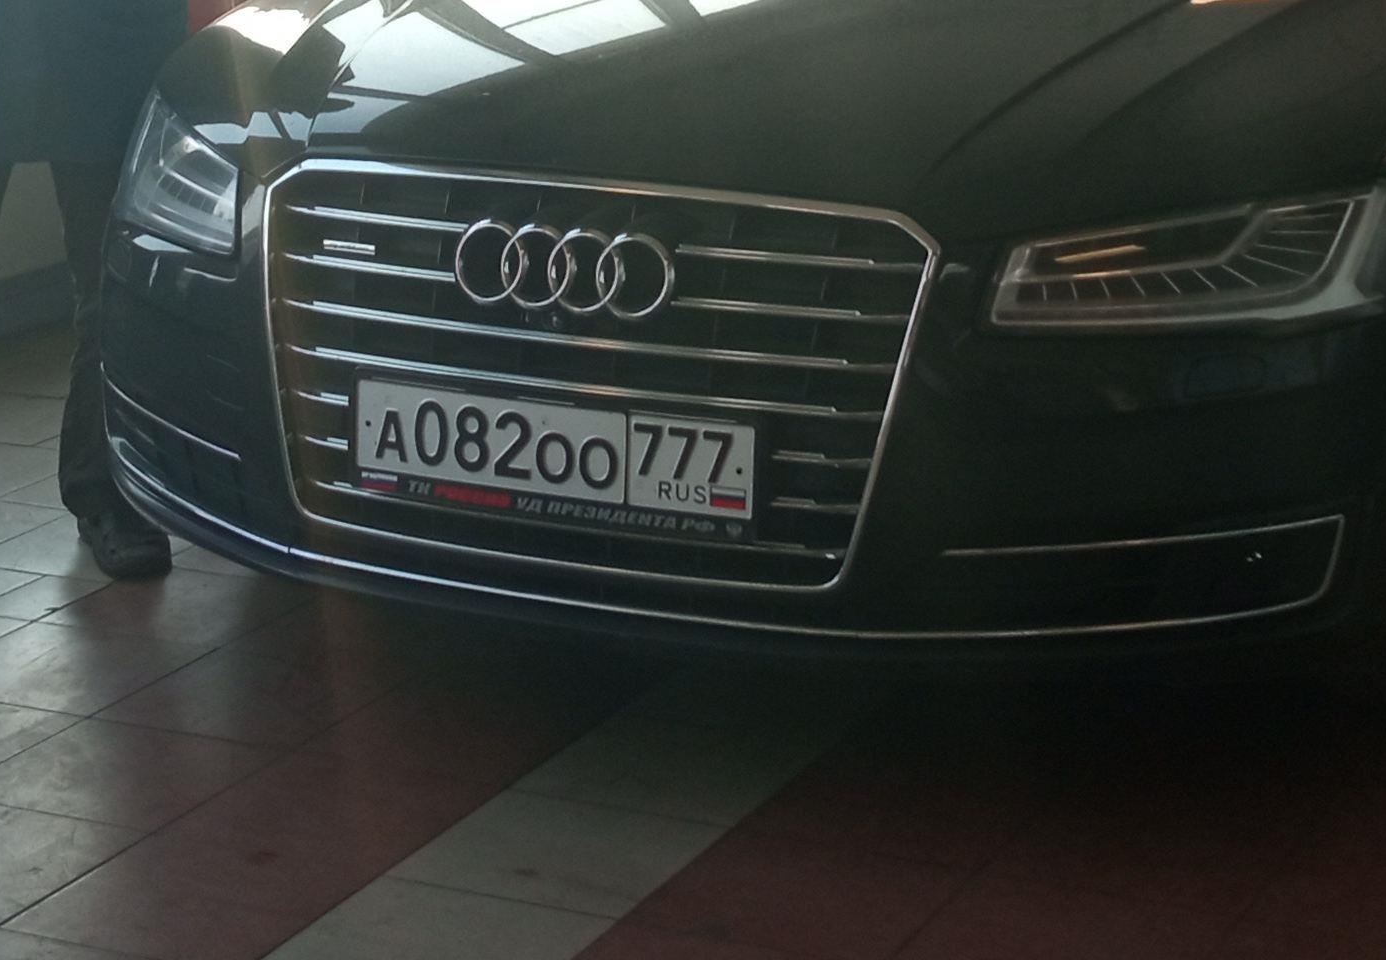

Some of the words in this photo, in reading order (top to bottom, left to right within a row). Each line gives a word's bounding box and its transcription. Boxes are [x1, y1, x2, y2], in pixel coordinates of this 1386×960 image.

[374, 400, 619, 491] А082ОО
[633, 422, 735, 484] 777
[657, 481, 707, 504] RUS
[546, 500, 677, 530] ПРЕЗИДЕНТА
